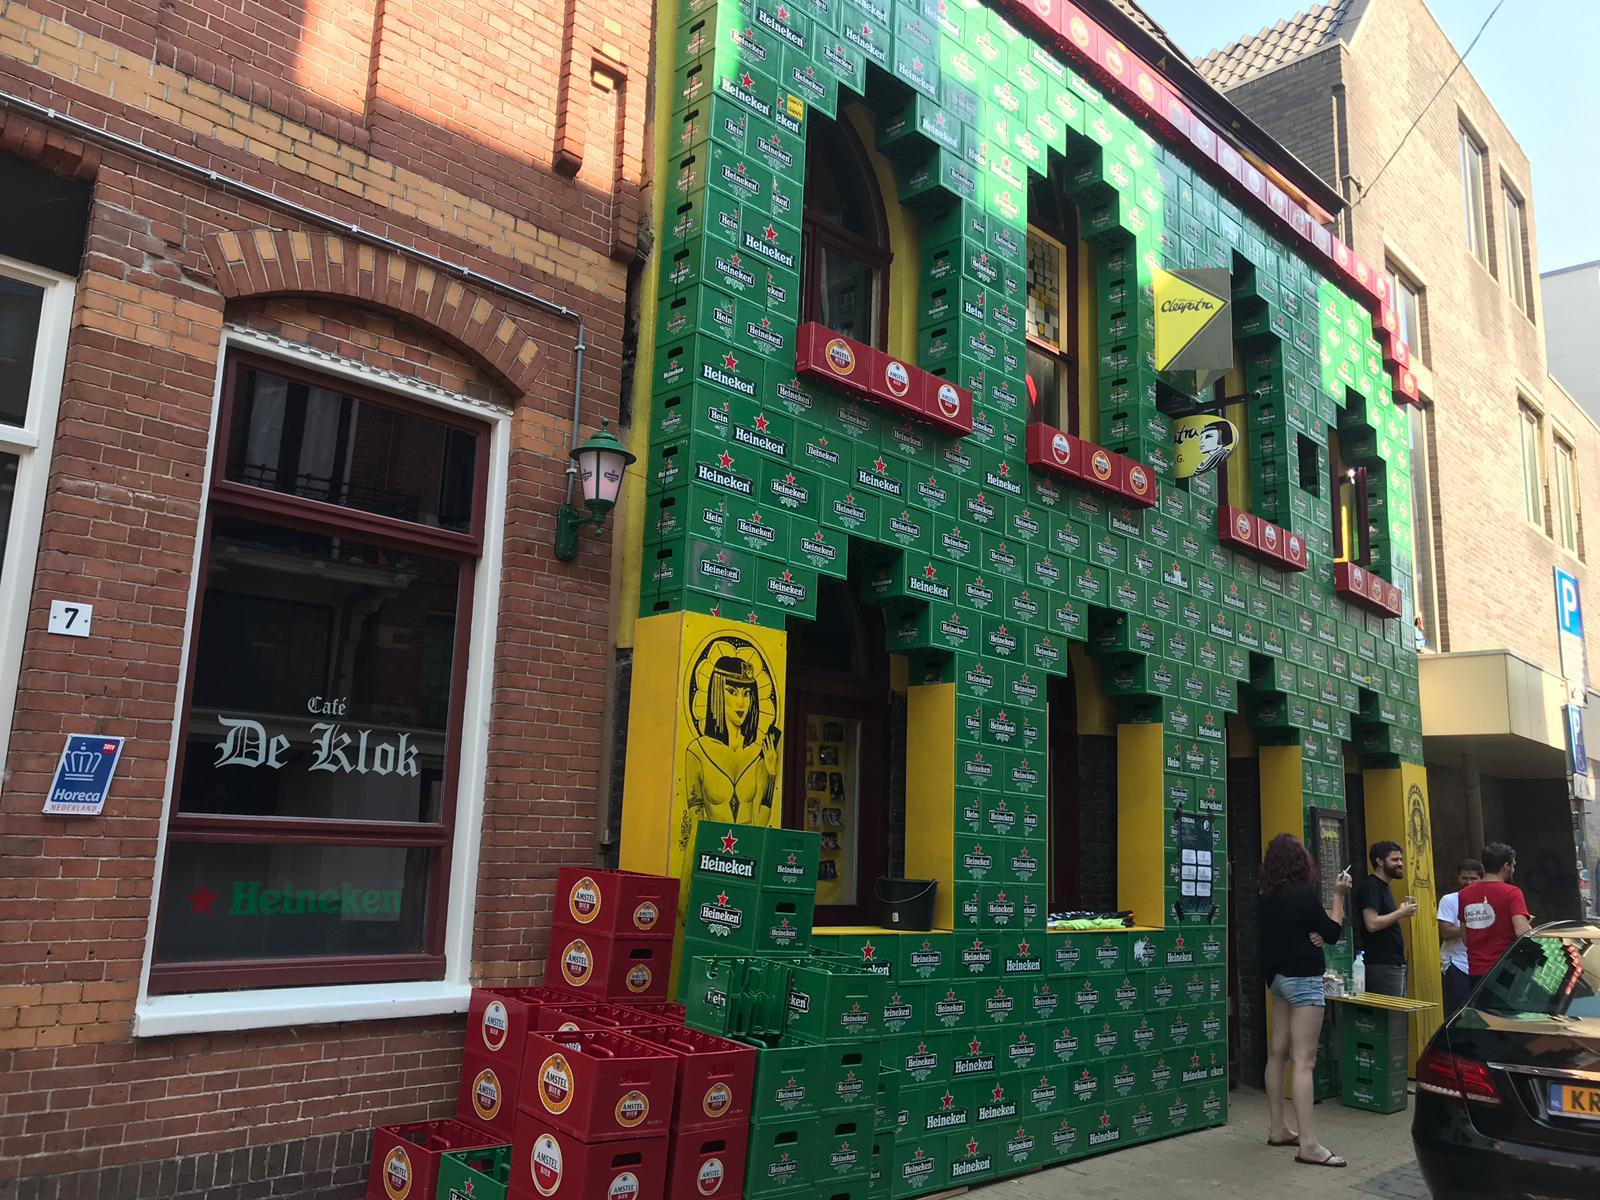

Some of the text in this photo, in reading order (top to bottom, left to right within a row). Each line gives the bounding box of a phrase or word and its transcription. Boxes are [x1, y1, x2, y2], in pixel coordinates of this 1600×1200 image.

[758, 12, 804, 47] Heineken
[734, 32, 765, 57] Heineken
[846, 28, 885, 61] Heineken
[826, 49, 852, 71] Heineken
[795, 71, 825, 94] Heineken
[900, 62, 935, 93] Heineken
[722, 78, 770, 115] Heineken
[923, 119, 957, 145] Heineken
[760, 141, 791, 162] Heineken
[725, 168, 757, 191] Heineken
[746, 234, 792, 267] Heineken
[718, 260, 752, 284] Heineken
[1161, 297, 1214, 314] Cleopatra
[750, 326, 781, 345] Heineken
[832, 348, 850, 361] AMSTEL
[663, 367, 684, 379] Heineken
[704, 364, 754, 394] Heineken
[890, 371, 906, 381] AMSTEL
[780, 387, 810, 404] Heineken
[736, 428, 784, 454] Heineken
[808, 445, 837, 462] Heineken
[945, 452, 969, 465] Heineken
[699, 465, 750, 492] Heineken
[859, 471, 900, 494] Heineken
[987, 474, 1020, 493] Heineken
[772, 482, 806, 499] Heineken
[920, 485, 944, 499] Heineken
[836, 502, 864, 518] Heineken
[968, 500, 992, 516] Heineken
[740, 522, 772, 538] Heineken
[892, 520, 918, 534] Heineken
[1016, 518, 1037, 531] Heineken
[944, 536, 968, 550] Heineken
[1058, 531, 1078, 544] Heineken
[803, 541, 833, 556] Heineken
[991, 551, 1014, 564] Heineken
[1036, 565, 1057, 578] Heineken
[770, 580, 803, 596] Heineken
[911, 578, 949, 597] Heineken
[1079, 578, 1098, 589] Heineken
[967, 586, 991, 599] Heineken
[1014, 600, 1036, 612] Heineken
[1562, 578, 1577, 627] P
[64, 607, 79, 629] 7
[1058, 611, 1078, 623] Heineken
[942, 623, 967, 636] Heineken
[991, 634, 1015, 646] Heineken
[1035, 646, 1057, 658] Heineken
[967, 673, 991, 686] Heineken
[1014, 683, 1036, 695] Heineken
[308, 696, 346, 716] Café
[214, 714, 419, 778] De Klok
[54, 789, 100, 801] Horeca
[701, 854, 754, 876] Heineken
[777, 865, 804, 874] Heineken
[228, 880, 404, 916] Heineken
[576, 892, 595, 903] AMSTEL
[702, 907, 740, 924] Heineken
[771, 928, 796, 937] Heineken
[568, 954, 587, 965] AMSTEL
[912, 954, 939, 963] Heineken
[964, 953, 989, 961] Heineken
[1006, 959, 1040, 971] Heineken
[938, 1005, 963, 1013] Heineken
[487, 1016, 504, 1028] AMSTEL
[843, 1014, 867, 1022] Heineken
[1011, 1046, 1033, 1054] Heineken
[908, 1058, 936, 1067] Heineken
[955, 1058, 993, 1073] Heineken
[545, 1071, 567, 1088] AMSTEL
[479, 1084, 496, 1098] AMSTEL
[548, 1085, 561, 1096] BIER
[838, 1083, 862, 1091] Heineken
[777, 1090, 803, 1099] Heineken
[1033, 1090, 1055, 1099] Heineken
[979, 1103, 1016, 1120] Heineken
[927, 1111, 967, 1129] Heineken
[1008, 1140, 1033, 1151] Heineken
[536, 1152, 558, 1169] AMSTEL
[832, 1153, 856, 1162] Heineken
[390, 1163, 407, 1178] AMSTEL
[540, 1167, 551, 1177] BIER
[702, 1170, 720, 1178] AMSTEL
[770, 1162, 796, 1174] Heineken
[904, 1162, 932, 1174] Heineken
[953, 1158, 990, 1176] Heineken
[613, 1185, 634, 1193] AMSTEL
